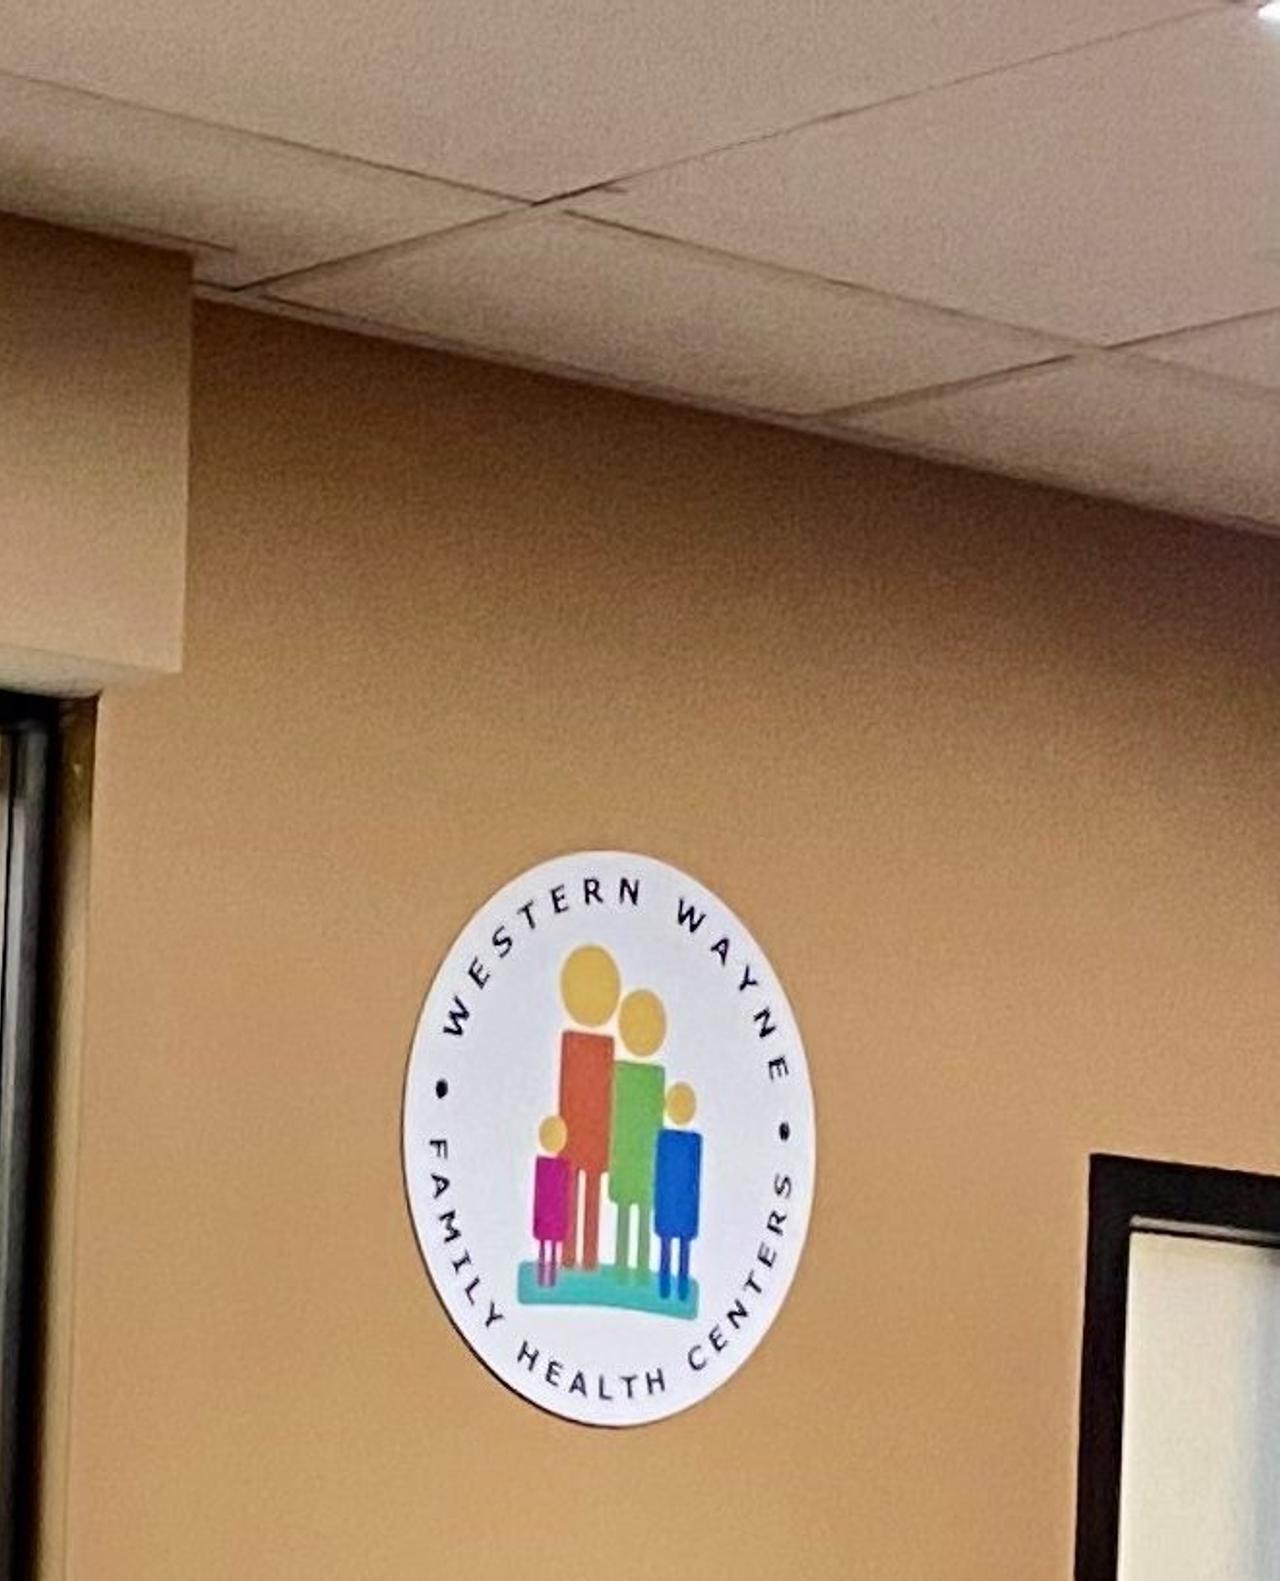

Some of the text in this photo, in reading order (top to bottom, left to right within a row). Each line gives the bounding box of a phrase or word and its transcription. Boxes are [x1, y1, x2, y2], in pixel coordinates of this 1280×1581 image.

[442, 876, 790, 1081] WESTERN WAYNE
[429, 1137, 794, 1401] FAMILY HEALTH CENTERS
